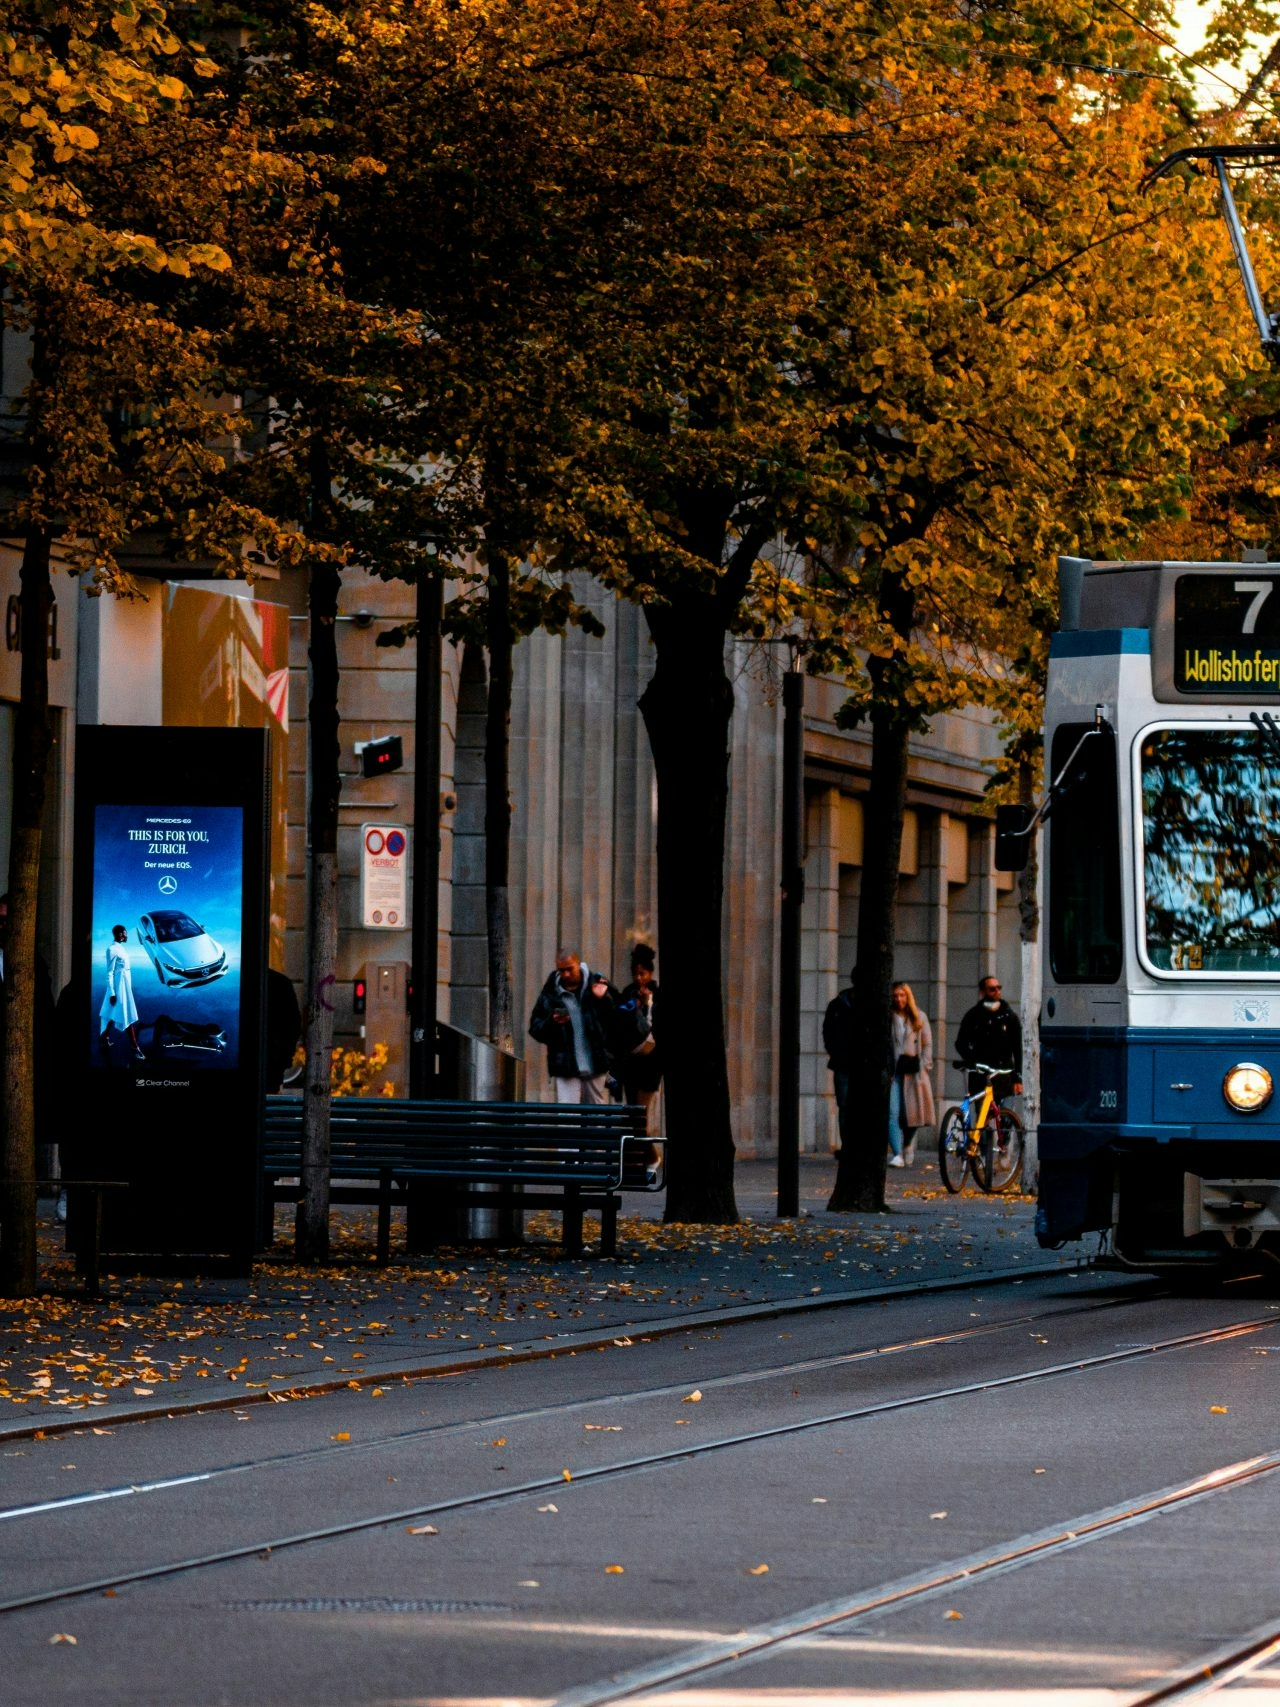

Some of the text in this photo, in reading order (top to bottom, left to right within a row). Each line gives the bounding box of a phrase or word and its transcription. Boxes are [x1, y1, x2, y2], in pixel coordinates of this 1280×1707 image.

[1234, 581, 1273, 634] 7
[128, 830, 210, 843] THIS IS FOR YOU,
[148, 843, 189, 855] ZURICH.
[176, 861, 192, 869] EQS.
